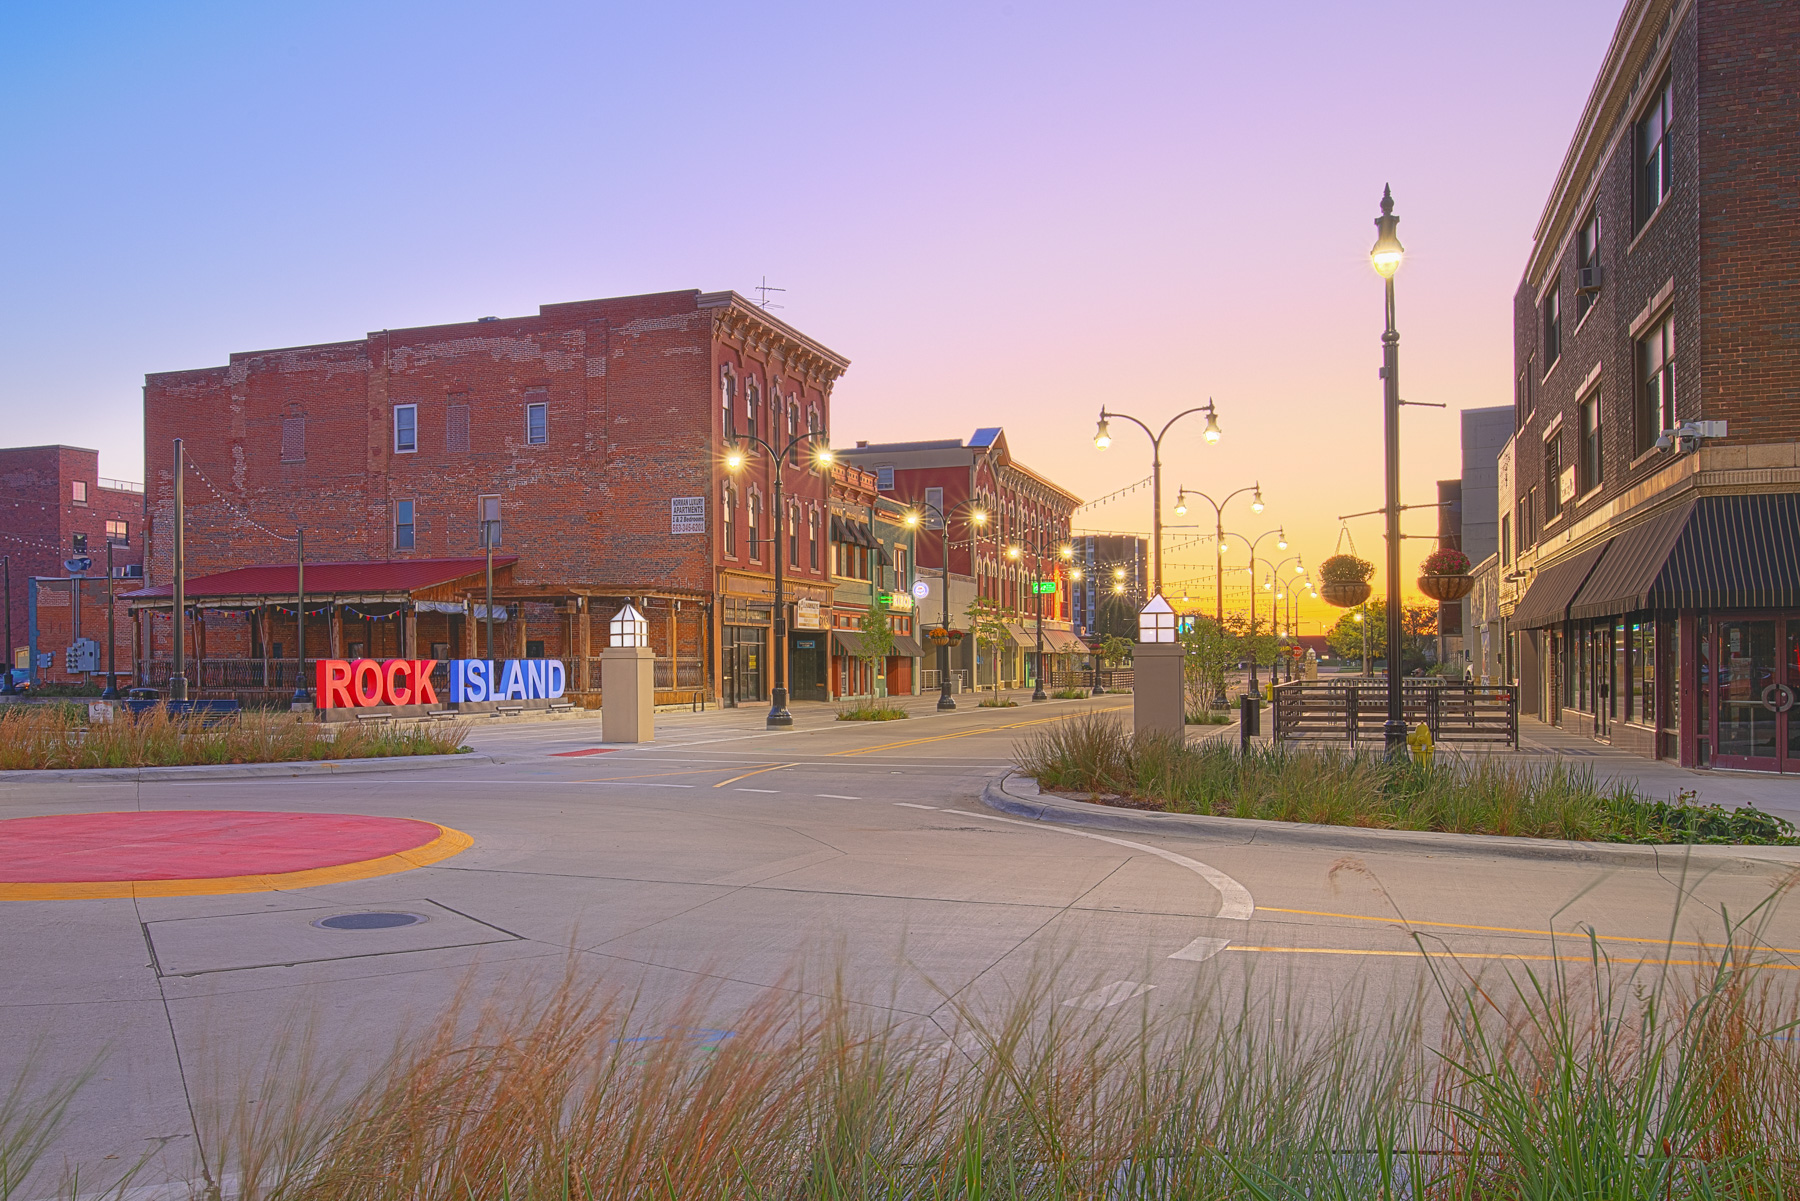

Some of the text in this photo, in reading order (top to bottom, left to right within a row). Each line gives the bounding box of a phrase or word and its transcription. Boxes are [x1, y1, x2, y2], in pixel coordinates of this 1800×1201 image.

[689, 498, 704, 506] LUXURY
[318, 659, 566, 708] ROCK ISLAND
